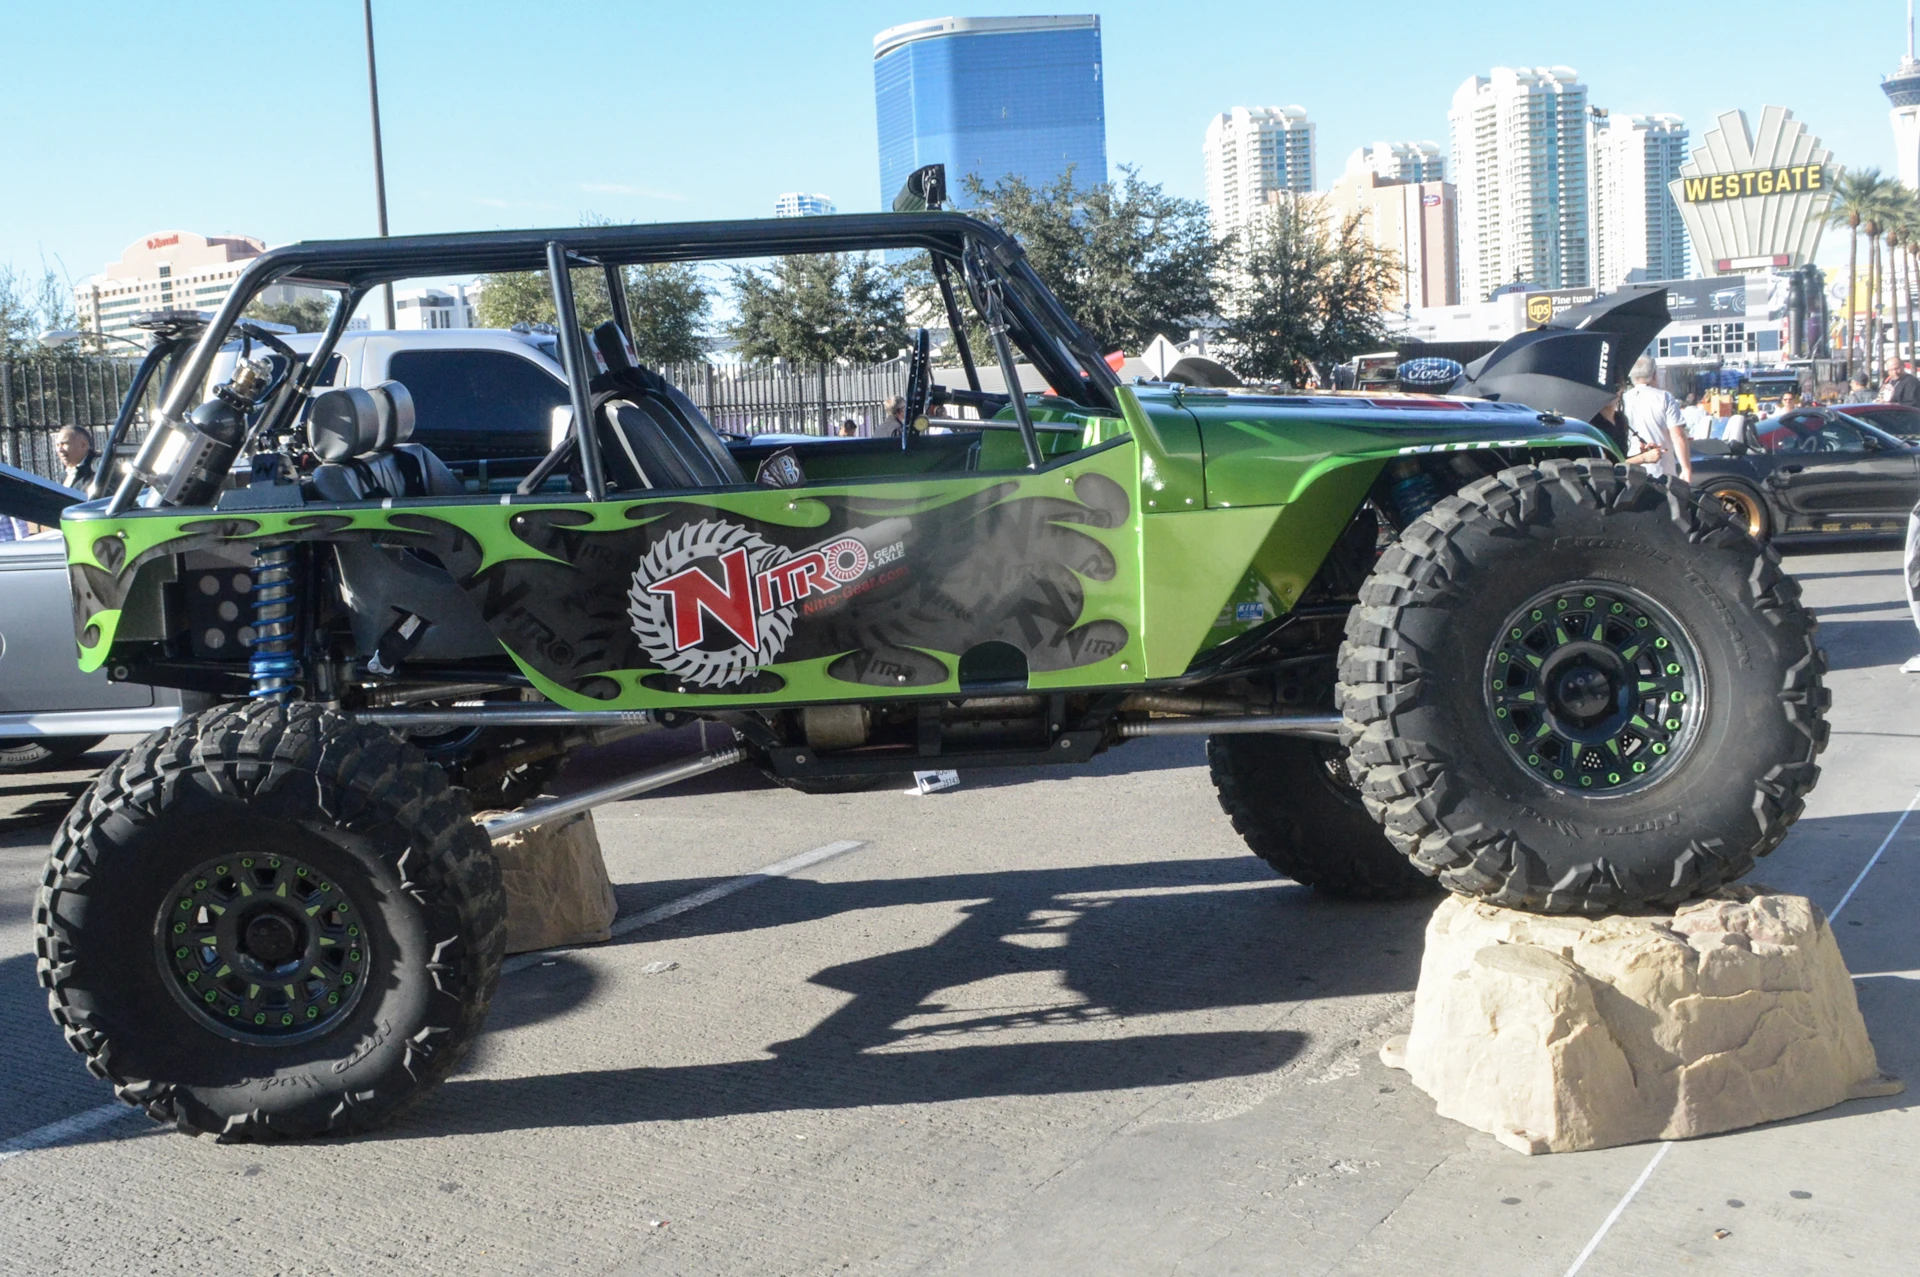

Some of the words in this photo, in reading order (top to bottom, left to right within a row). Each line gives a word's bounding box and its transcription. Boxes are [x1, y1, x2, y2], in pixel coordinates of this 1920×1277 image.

[1685, 165, 1821, 201] WESTGATE
[1552, 296, 1570, 305] Fine
[1572, 294, 1594, 303] tune
[1530, 303, 1550, 320] ups
[1407, 360, 1451, 380] Ford
[1599, 341, 1610, 385] NITTO
[867, 558, 876, 571] &
[878, 550, 906, 569] AXLE
[648, 546, 868, 651] NITRO
[873, 541, 904, 559] GEAR
[803, 565, 909, 616] Nitro-Gear.com
[1238, 603, 1263, 612] KING
